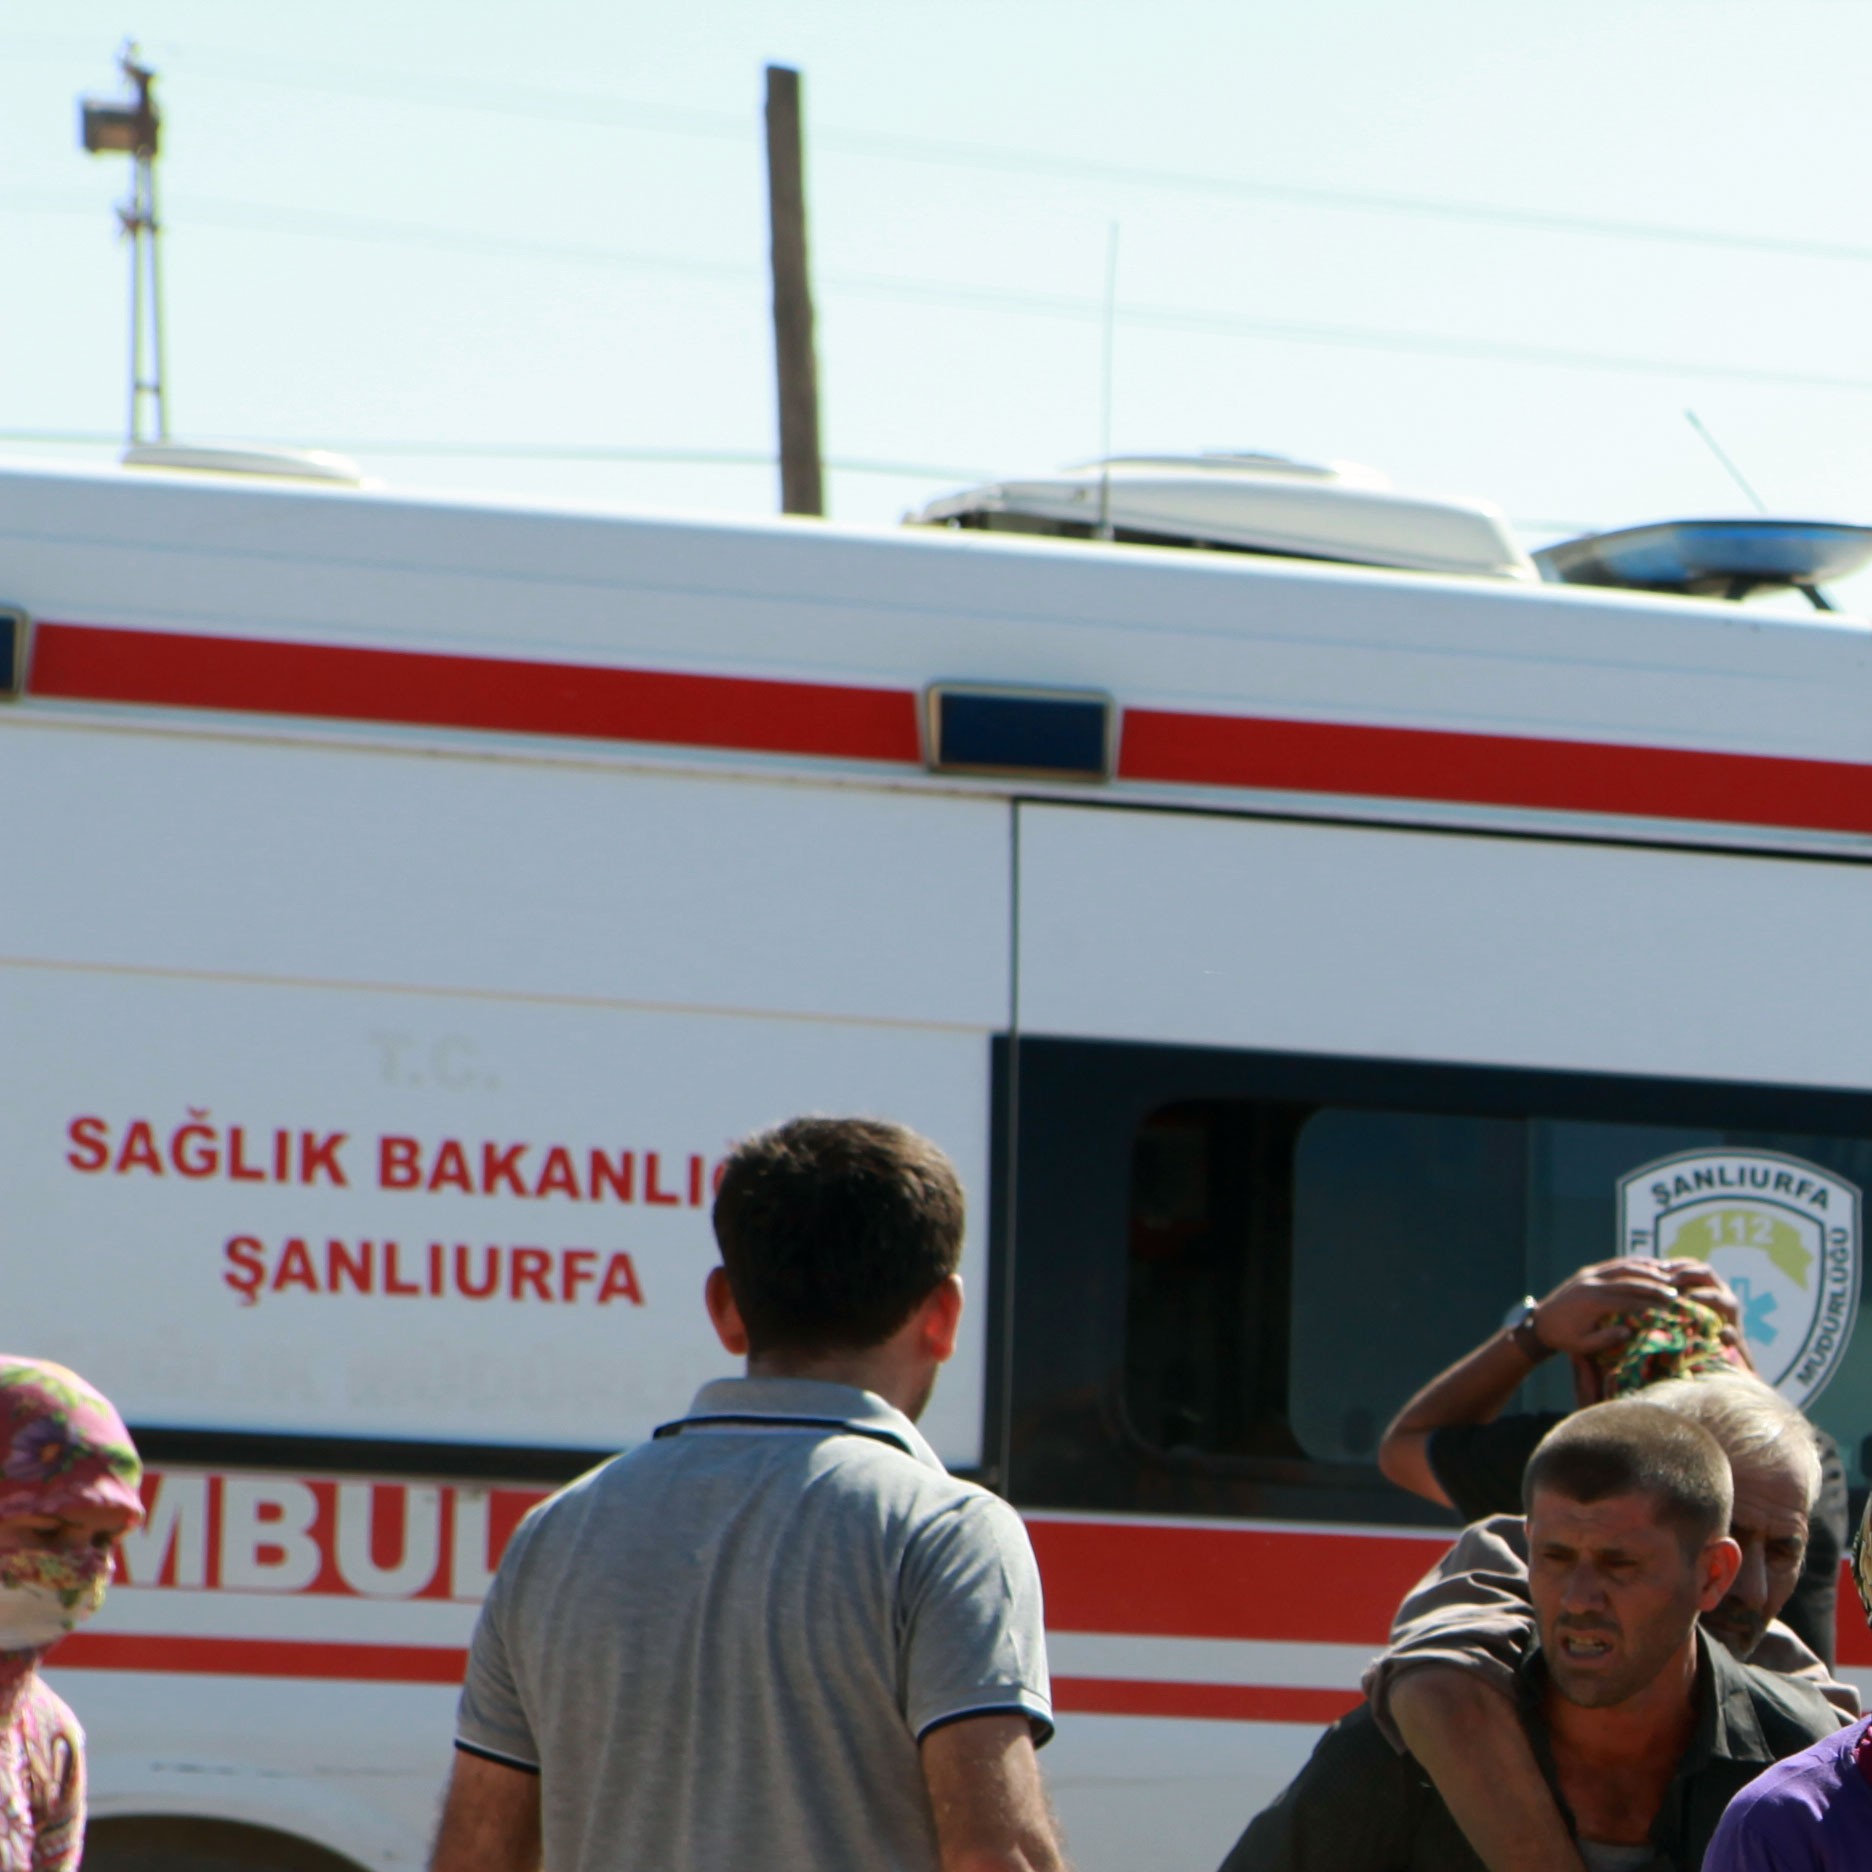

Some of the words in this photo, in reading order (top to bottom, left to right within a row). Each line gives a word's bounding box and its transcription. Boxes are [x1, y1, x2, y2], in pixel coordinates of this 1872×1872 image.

[66, 1107, 349, 1188] SAĞLIK
[377, 1134, 730, 1208] BAKANLI
[1650, 1165, 1830, 1211] ŞANLIURFA
[1704, 1215, 1773, 1245] 112
[223, 1235, 645, 1306] ŞANLIURFA
[1795, 1226, 1850, 1388] MÜDÜRLÜĞÜ
